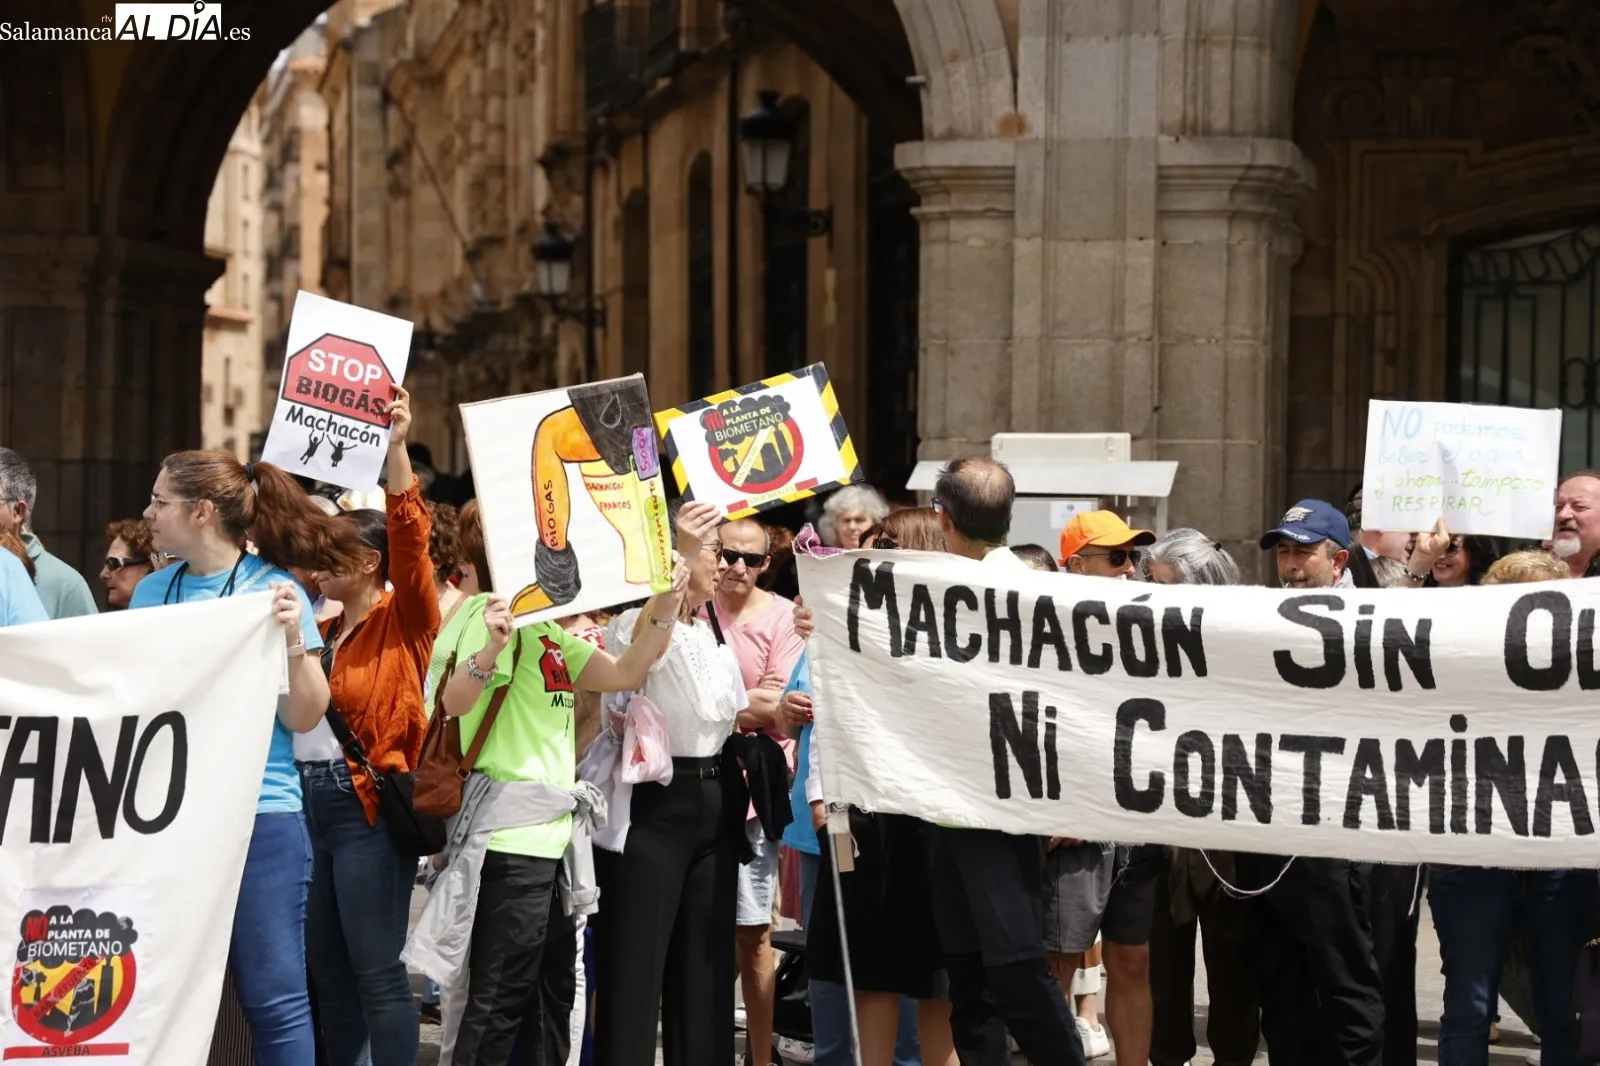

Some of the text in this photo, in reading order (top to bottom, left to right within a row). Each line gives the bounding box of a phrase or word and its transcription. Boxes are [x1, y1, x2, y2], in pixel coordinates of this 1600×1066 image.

[308, 349, 382, 386] STOP
[295, 376, 387, 418] BIOGÁS
[730, 405, 742, 414] LA
[285, 405, 380, 447] Machacón
[715, 412, 784, 442] BIOMETANO
[725, 406, 771, 426] PLANTA DE
[1380, 406, 1525, 443] NO podemos
[1441, 440, 1461, 465] el
[1391, 495, 1495, 517] RESPIRAR
[846, 557, 1208, 678] MACHACÓN
[25, 915, 49, 942] NO
[49, 915, 74, 925] A LA
[47, 928, 111, 940] PLANTA DE
[27, 940, 123, 958] BIOMETANO
[41, 1045, 91, 1057] ASVEBA
